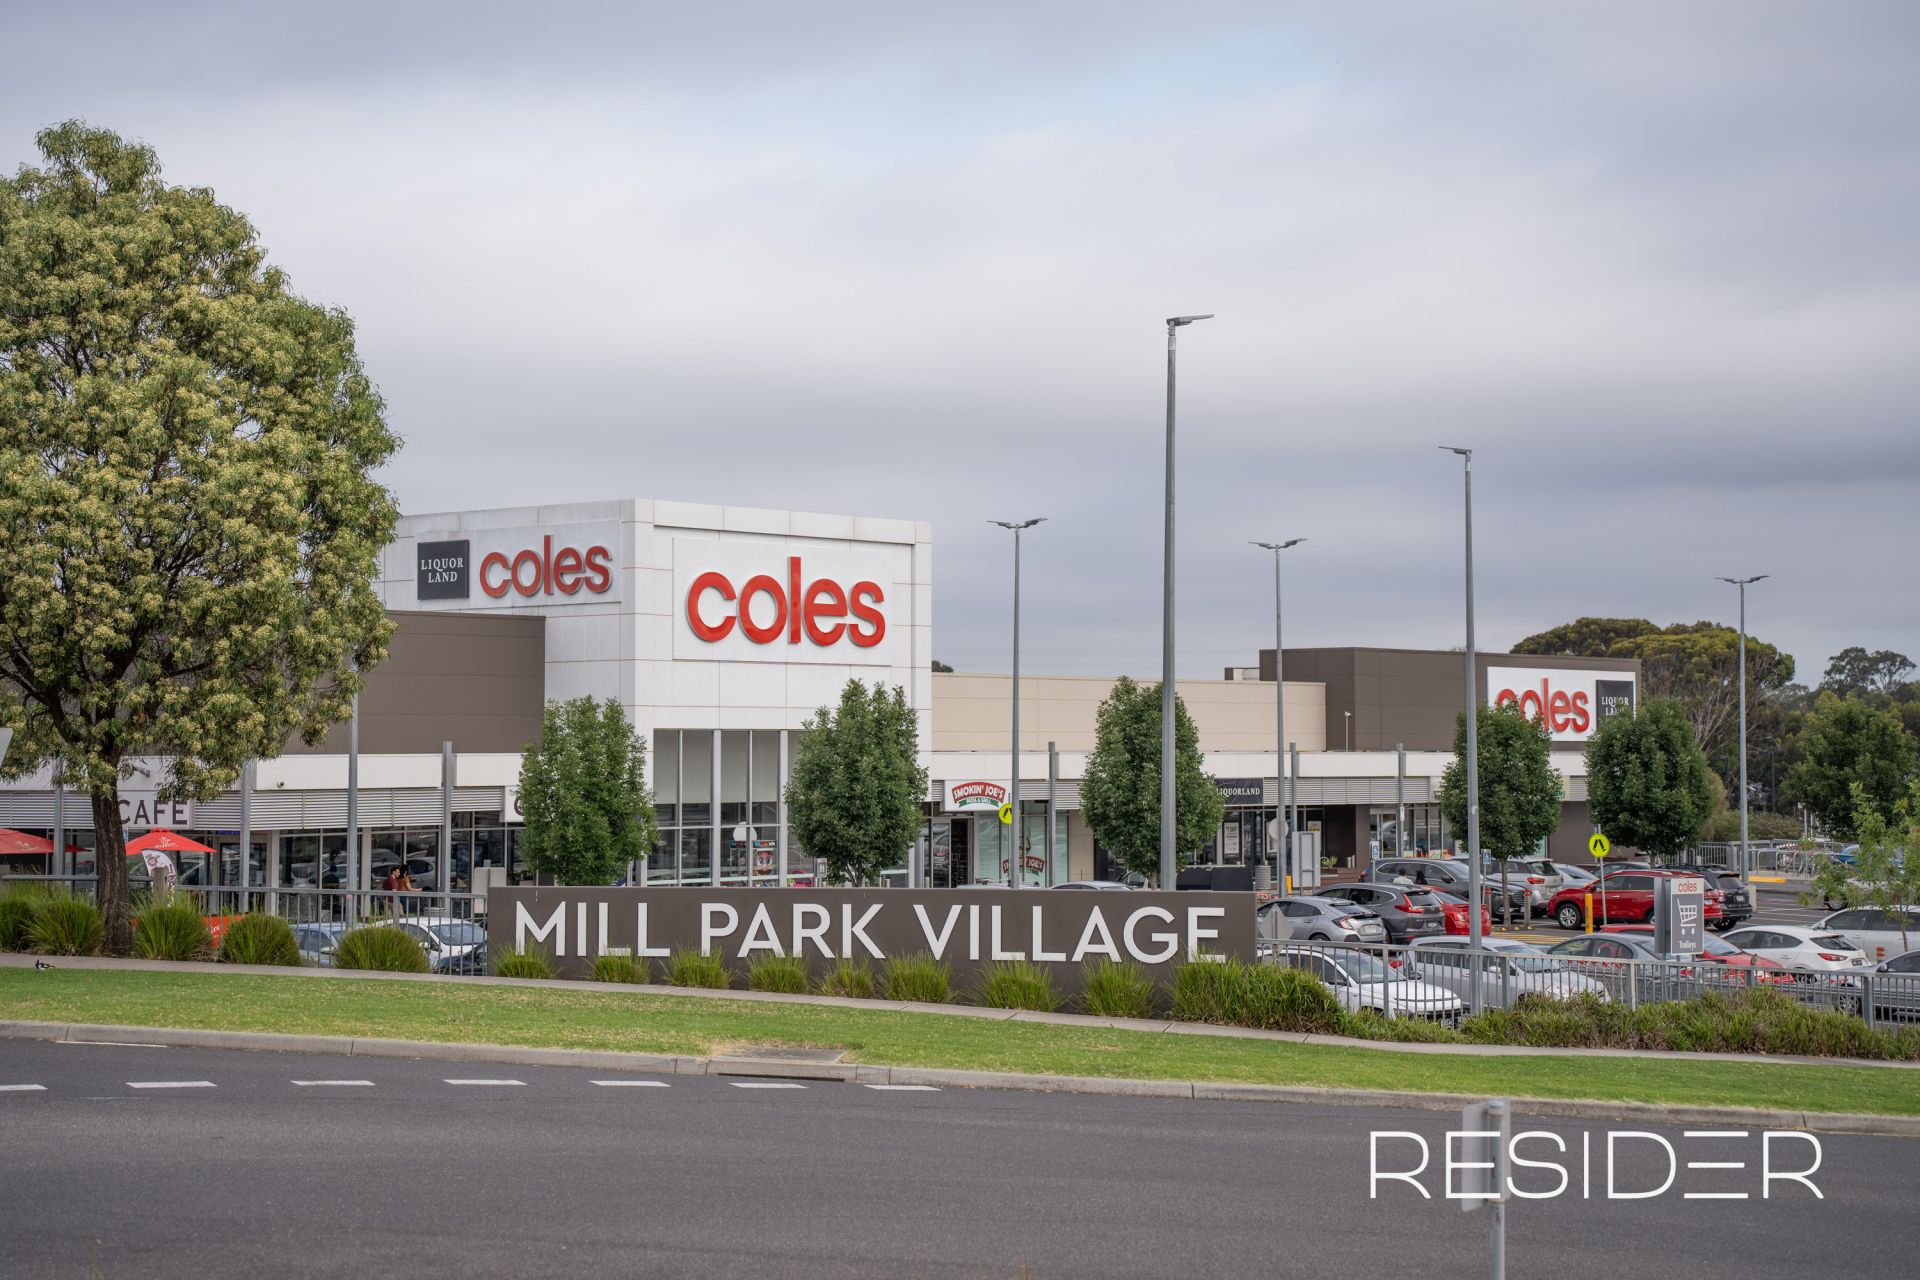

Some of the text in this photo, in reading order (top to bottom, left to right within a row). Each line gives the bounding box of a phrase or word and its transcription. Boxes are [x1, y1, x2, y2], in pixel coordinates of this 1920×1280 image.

[421, 557, 464, 572] LIQUOR
[480, 535, 613, 598] coles
[428, 571, 458, 583] LAND
[686, 556, 886, 648] coles
[1605, 707, 1624, 716] LA
[953, 785, 1004, 799] SMOKIN' JOE'S
[1678, 881, 1697, 892] coles
[516, 900, 1226, 964] MILL PARK VILLAGE
